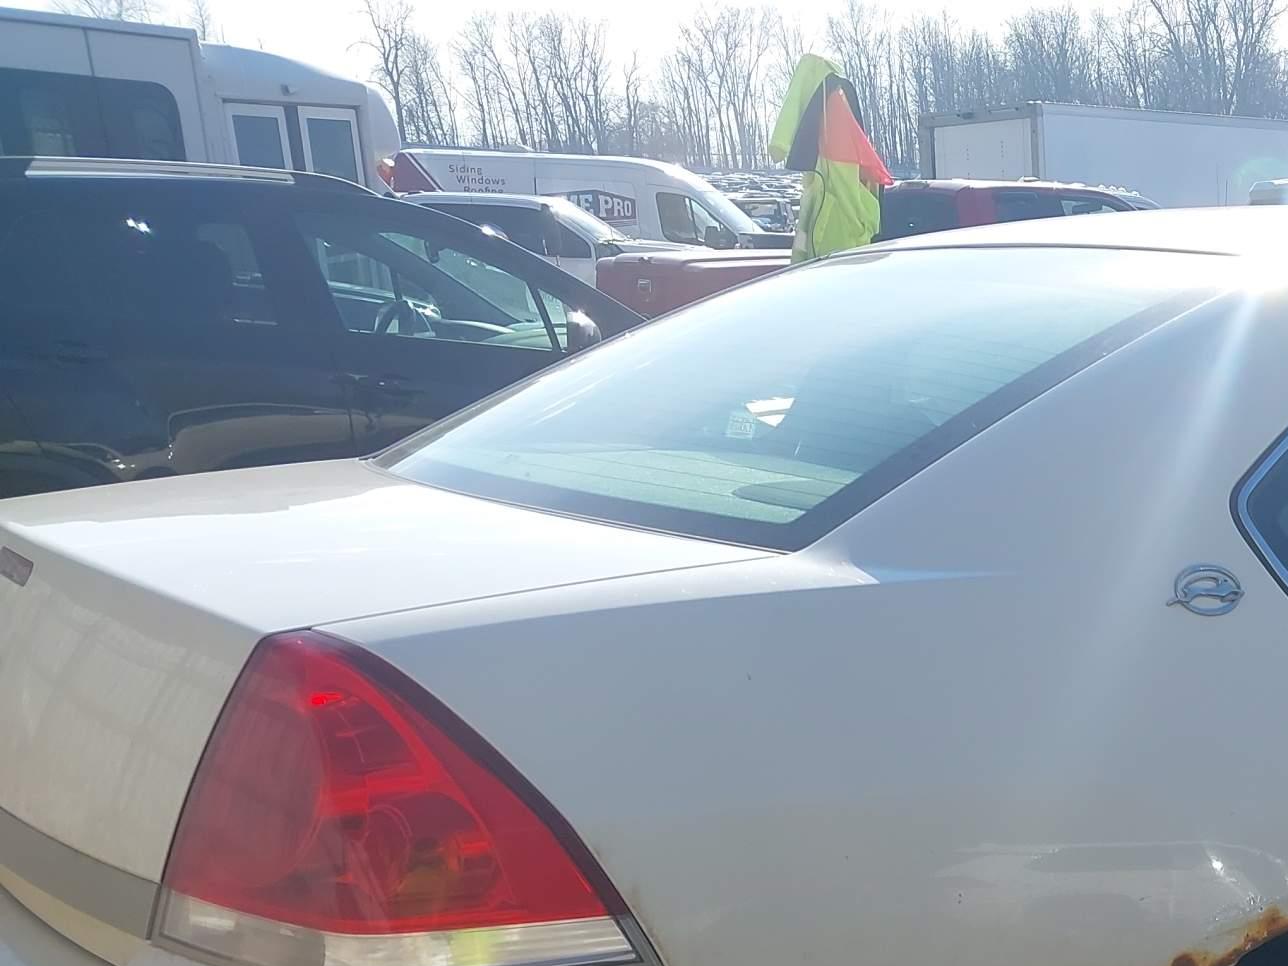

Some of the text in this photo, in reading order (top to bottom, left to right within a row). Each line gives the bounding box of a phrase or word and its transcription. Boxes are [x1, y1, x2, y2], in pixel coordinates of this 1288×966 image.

[448, 164, 482, 175] Siding
[456, 175, 506, 185] Windows
[598, 194, 632, 217] PRO
